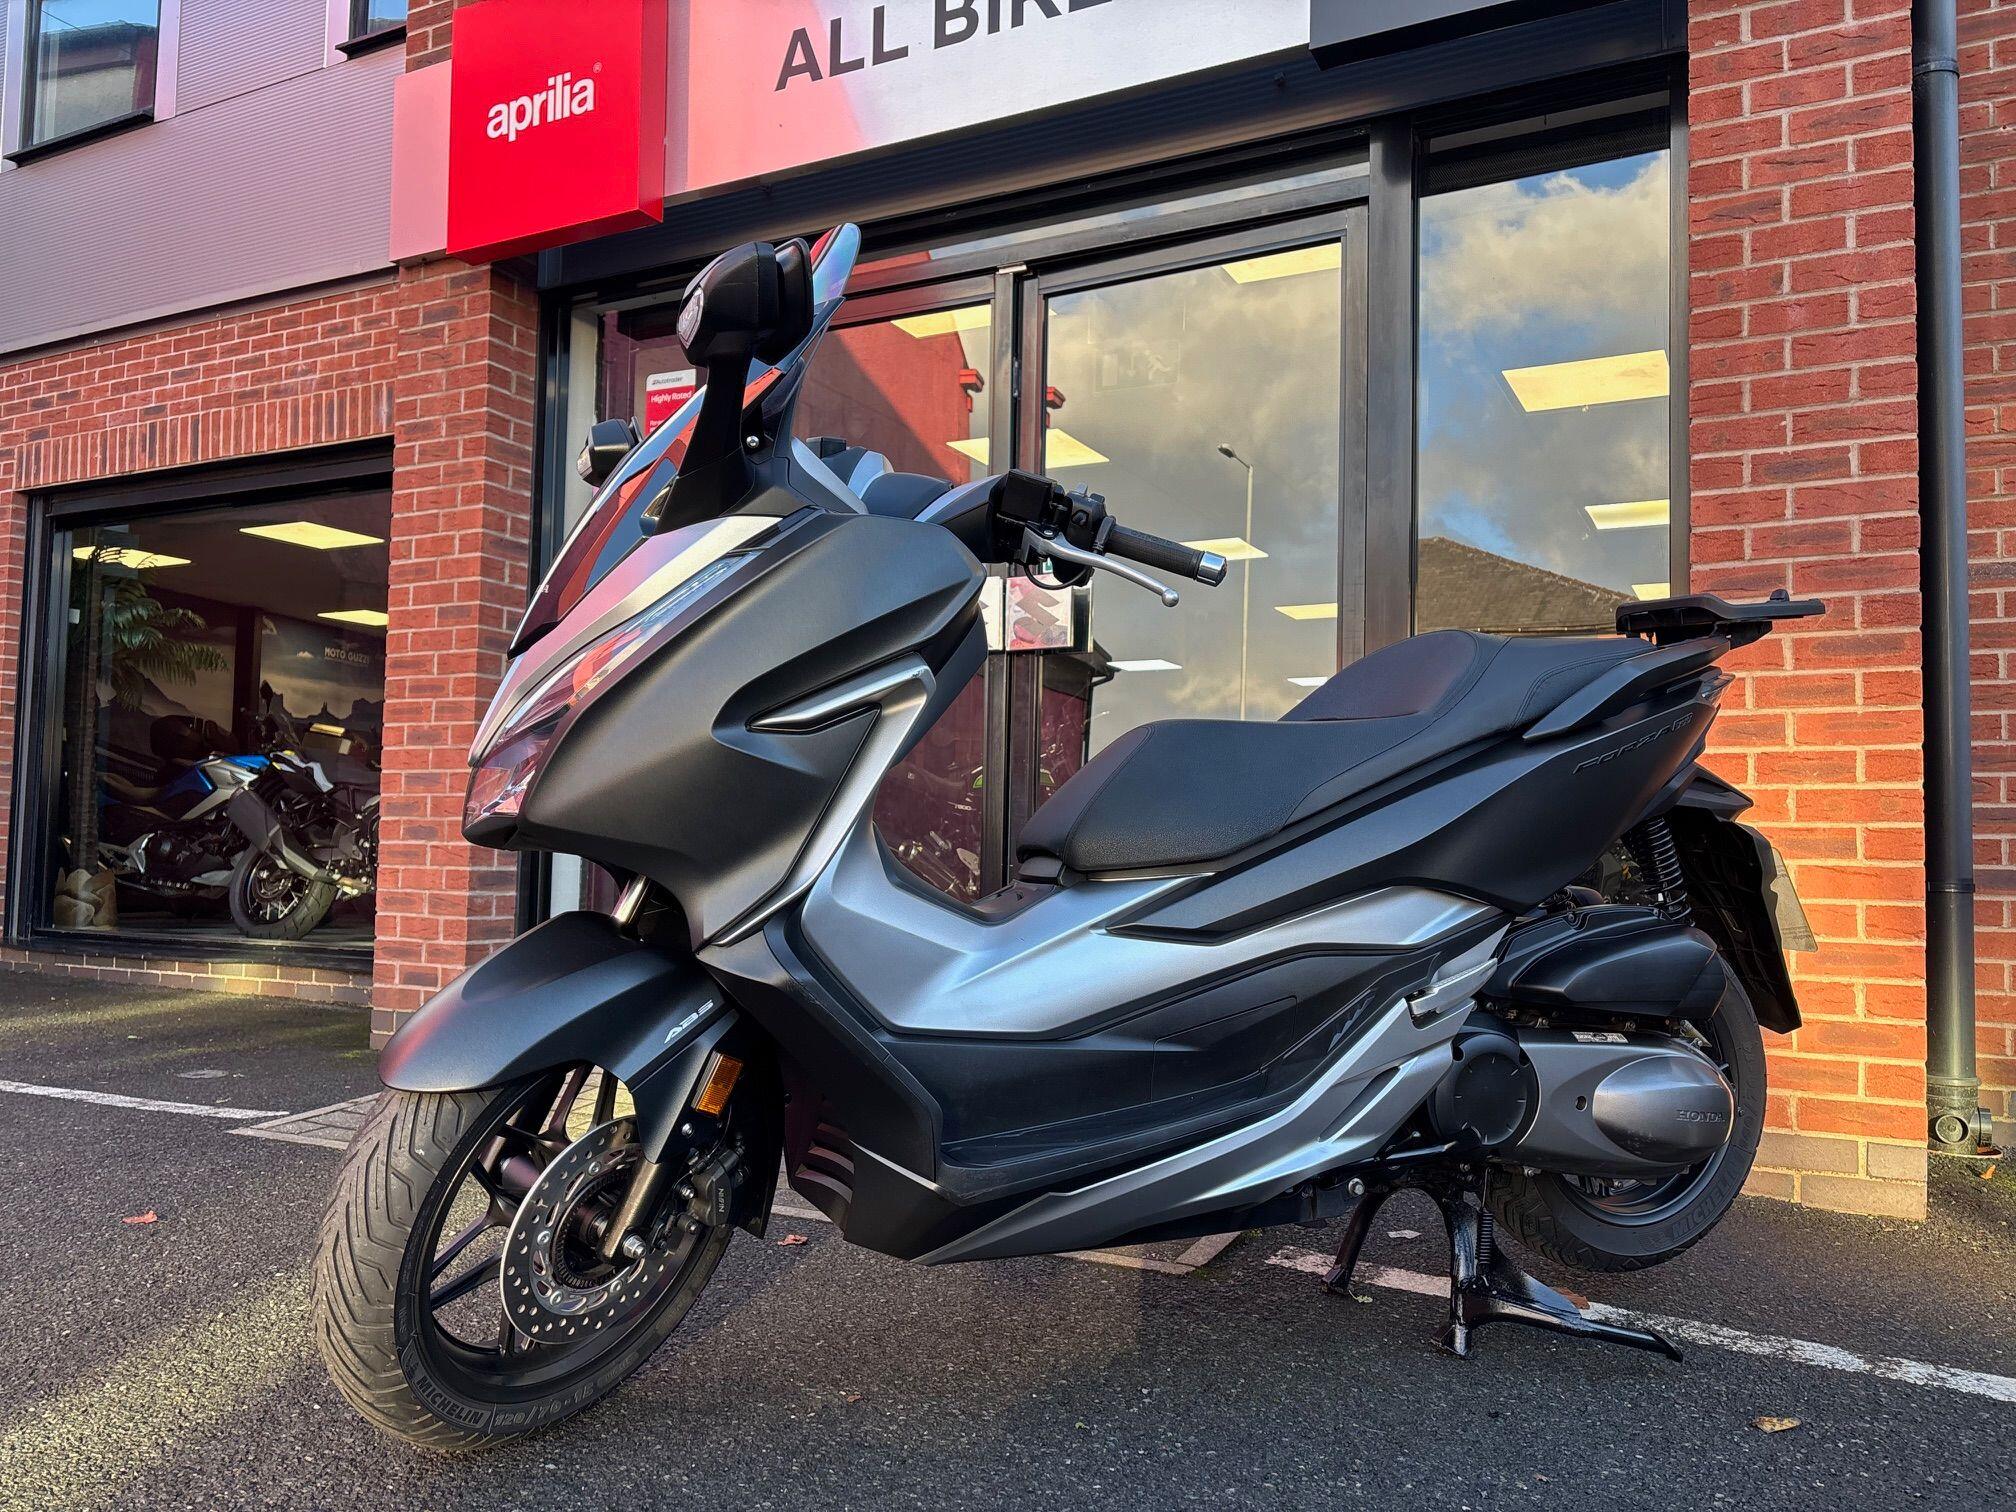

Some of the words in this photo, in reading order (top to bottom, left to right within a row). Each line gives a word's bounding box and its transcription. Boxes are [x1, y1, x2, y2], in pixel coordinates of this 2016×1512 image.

[774, 5, 909, 92] ALL
[486, 71, 596, 143] aprilia
[650, 393, 671, 405] Highly
[671, 390, 693, 401] Rated
[324, 646, 346, 659] MOTO
[664, 999, 714, 1044] ABS
[1676, 1109, 1726, 1122] HONDA
[415, 1375, 485, 1425] MICHELIN
